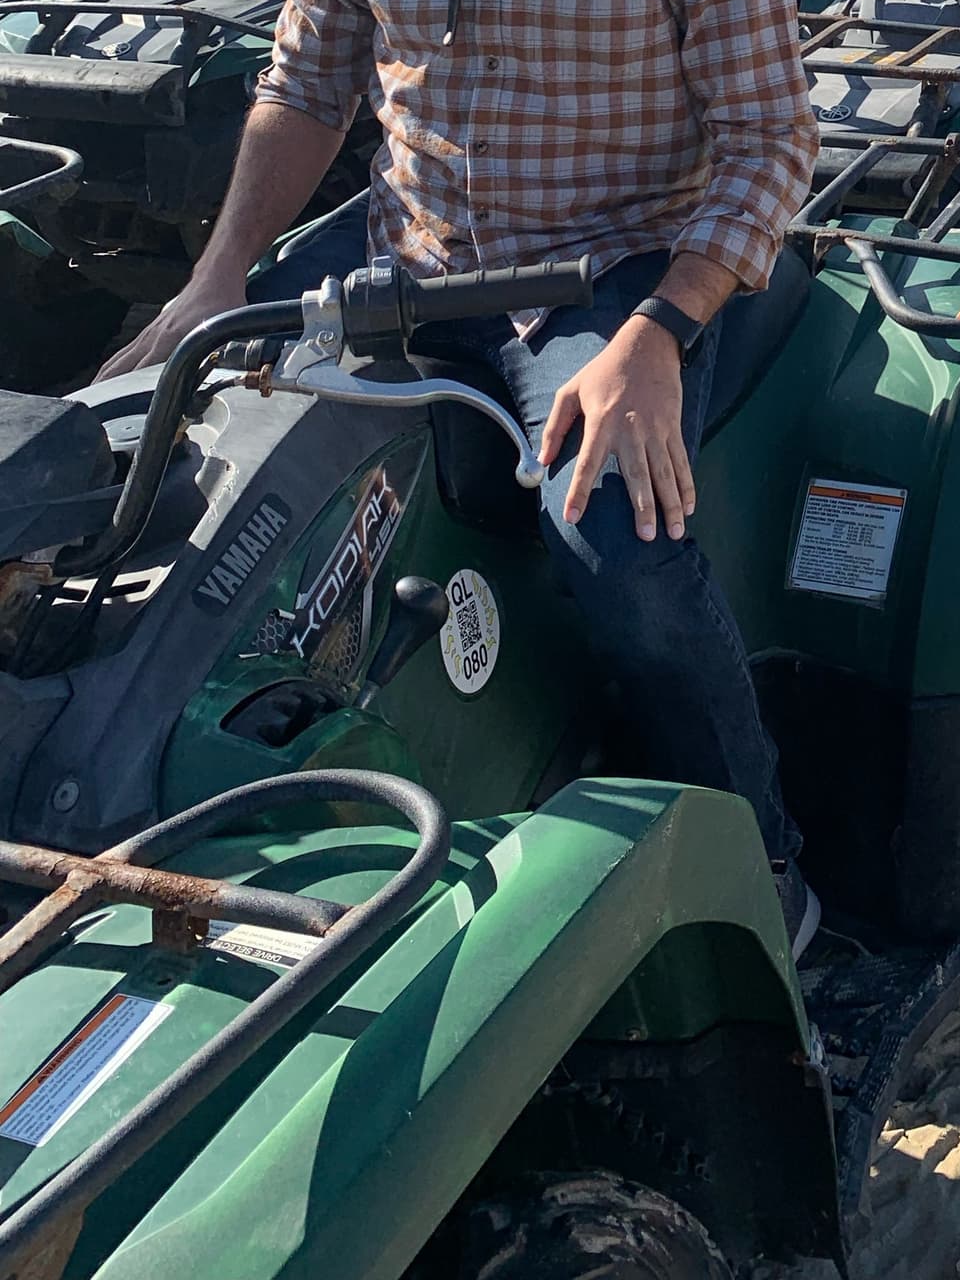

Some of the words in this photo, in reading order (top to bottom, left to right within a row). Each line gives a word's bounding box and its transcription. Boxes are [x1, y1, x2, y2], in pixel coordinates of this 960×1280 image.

[197, 503, 288, 606] YAMAHA
[369, 498, 400, 562] 450
[290, 469, 392, 658] KODIAK
[451, 577, 473, 607] QL
[463, 643, 488, 680] 080
[253, 951, 282, 962] DRIVE
